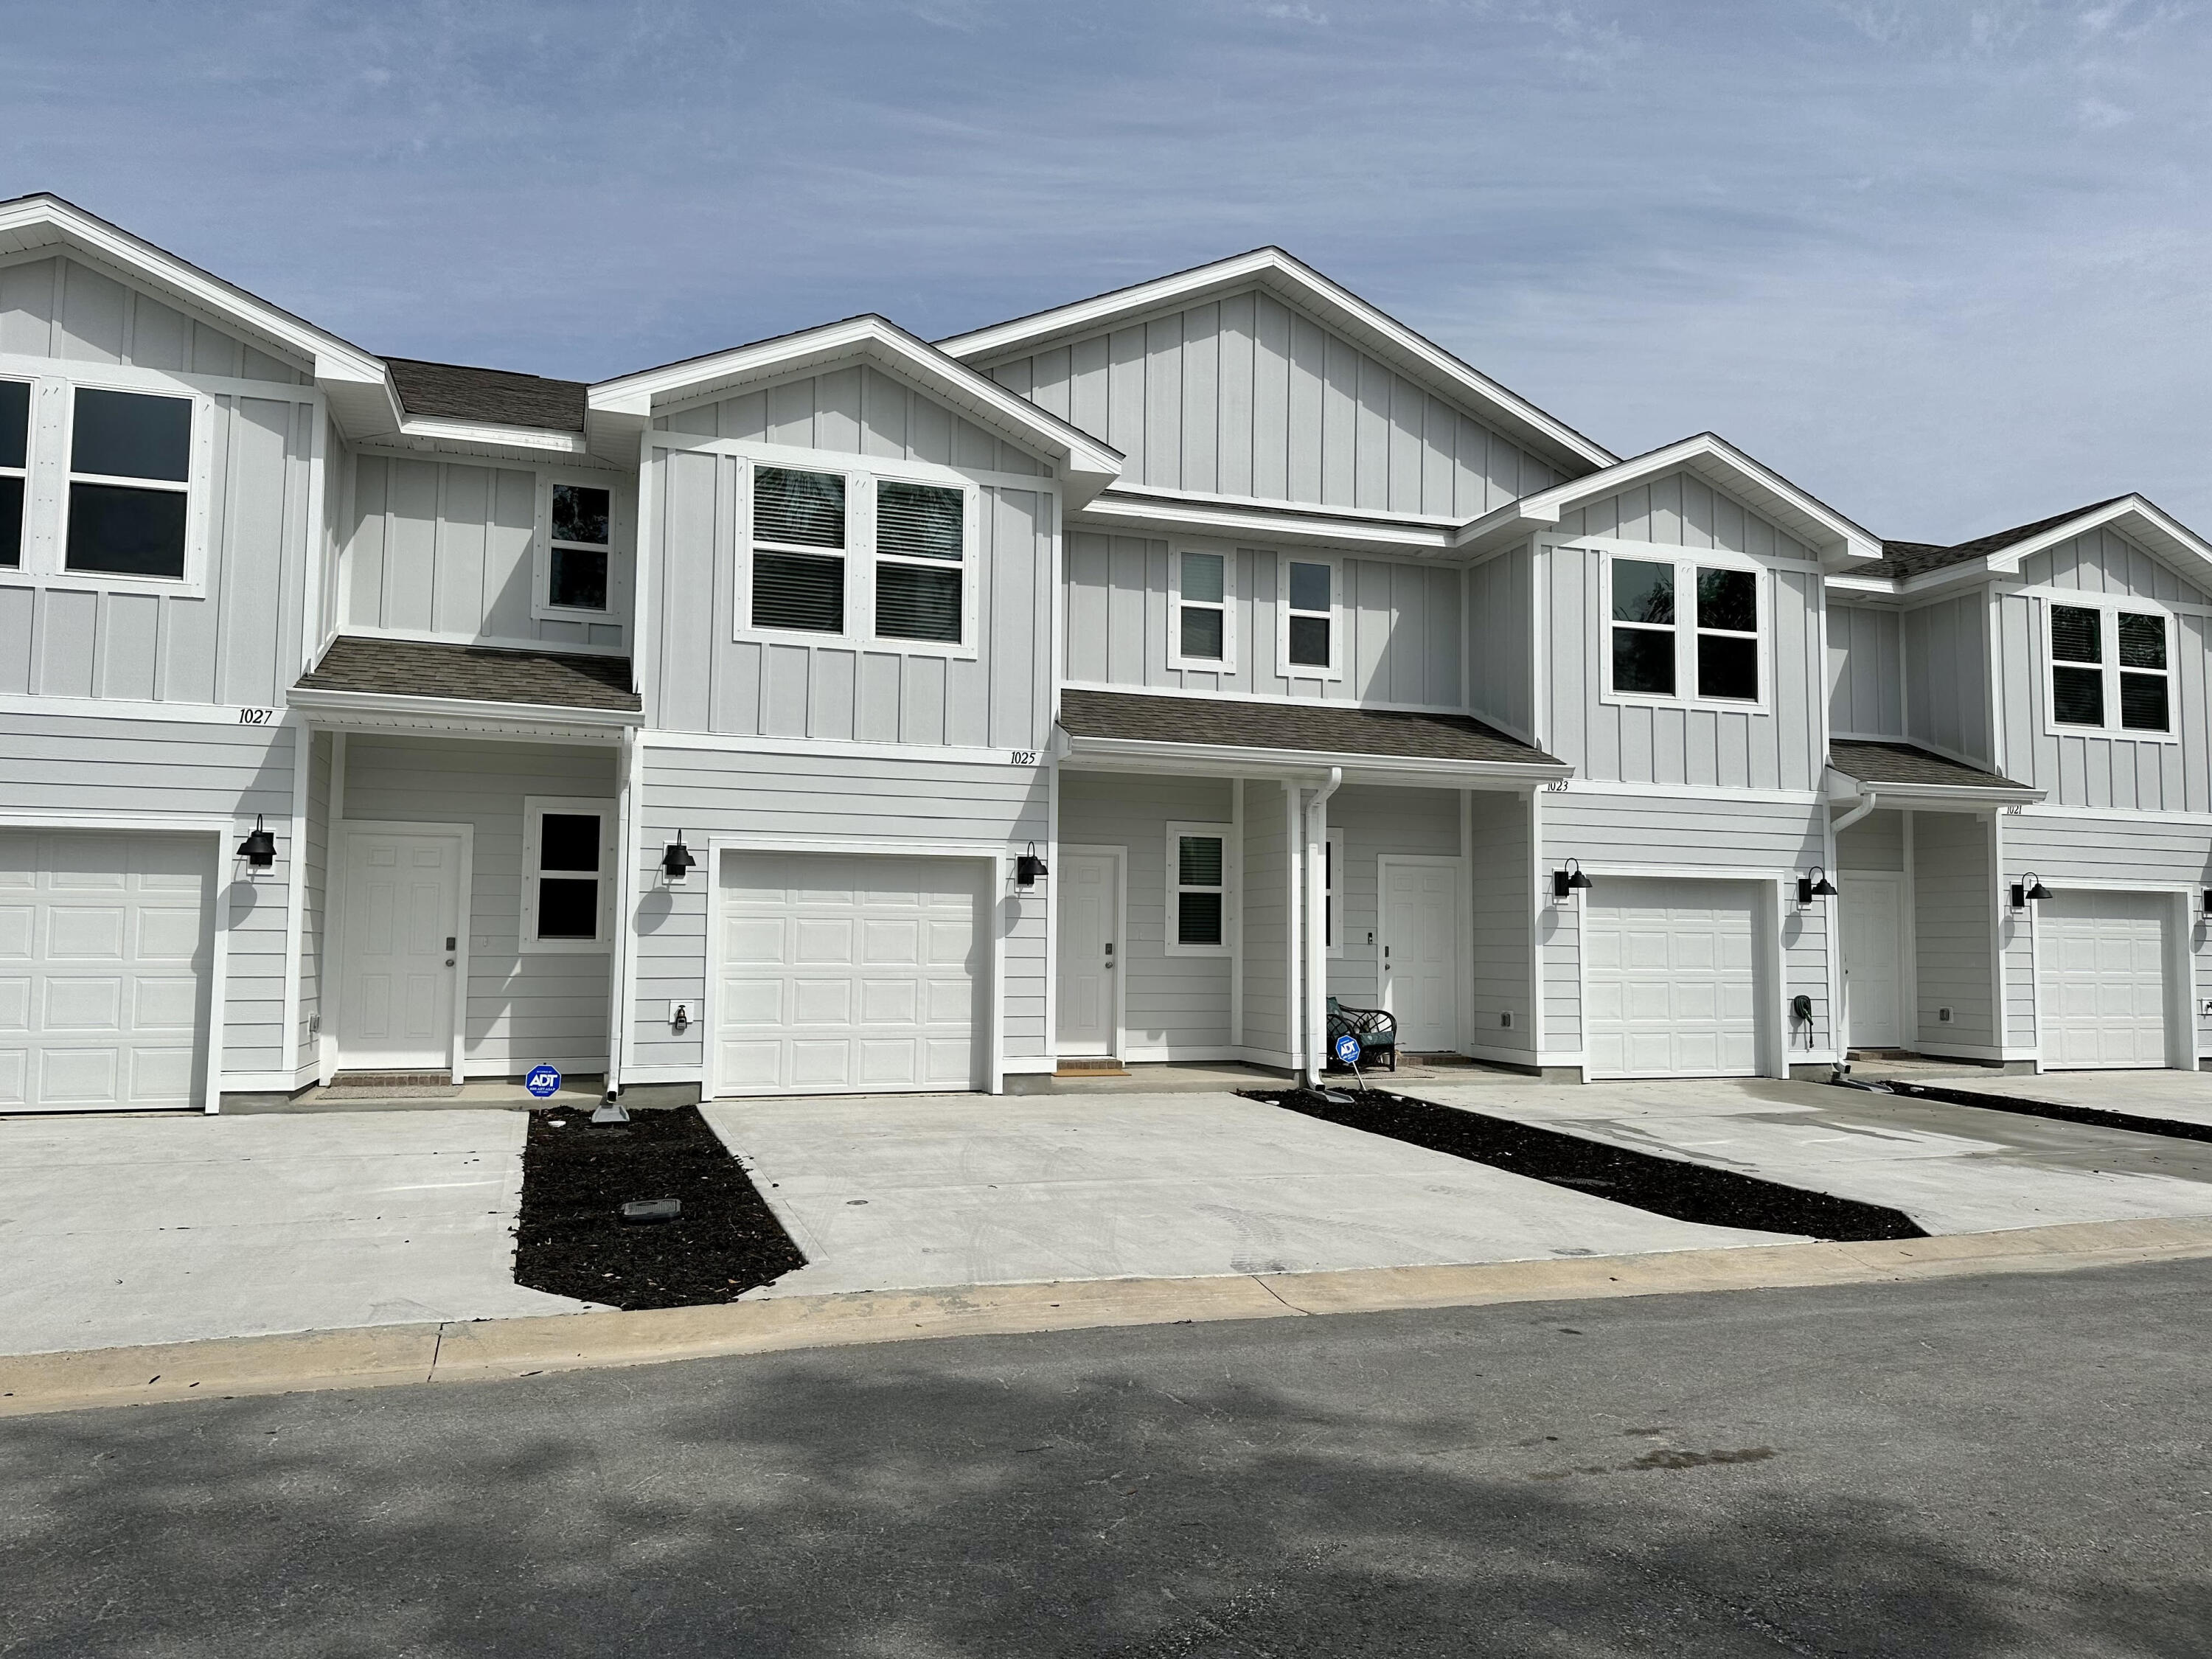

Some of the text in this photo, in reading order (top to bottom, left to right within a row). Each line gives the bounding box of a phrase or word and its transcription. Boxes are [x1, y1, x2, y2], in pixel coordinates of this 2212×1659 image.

[239, 708, 273, 724] 1027
[1011, 751, 1037, 765] 1025
[1548, 781, 1568, 791] 1023
[1341, 1040, 1355, 1056] ADT
[529, 1074, 558, 1087] ADT
